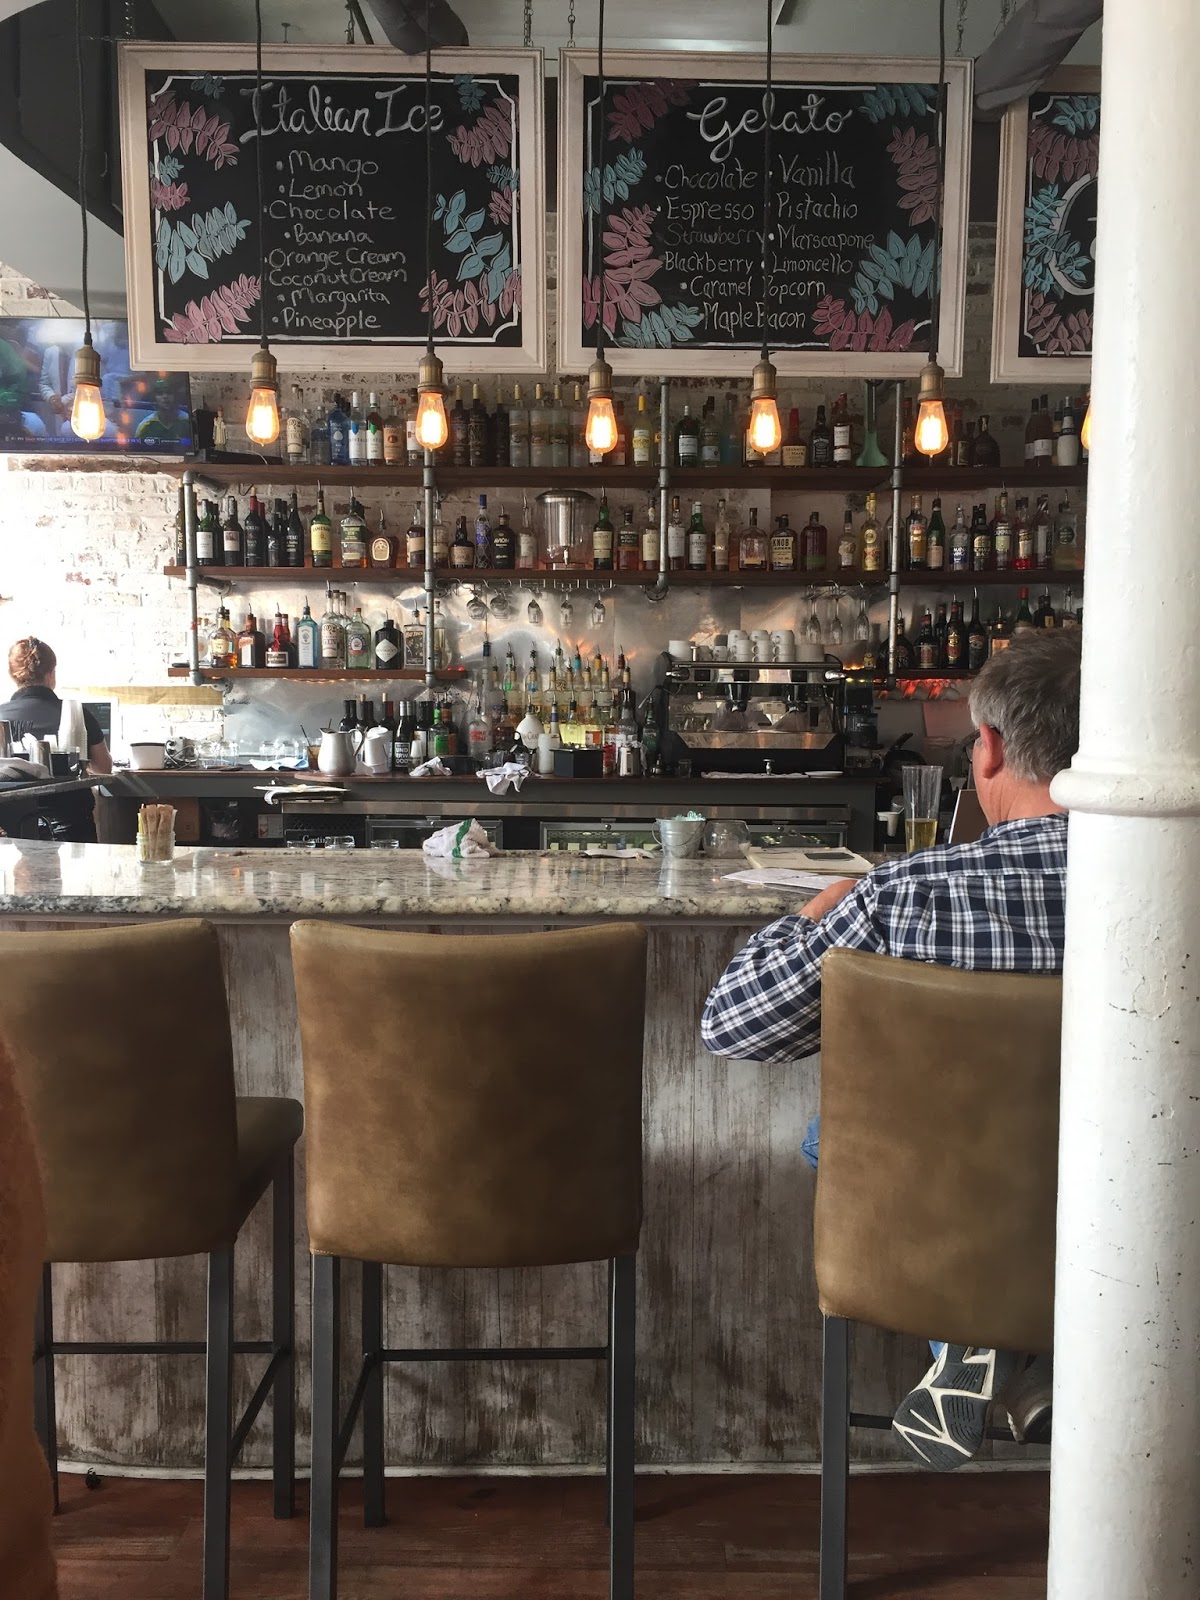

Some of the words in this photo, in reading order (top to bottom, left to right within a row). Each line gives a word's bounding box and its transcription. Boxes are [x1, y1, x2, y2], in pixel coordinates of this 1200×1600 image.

[239, 82, 371, 143] Italian
[374, 84, 444, 138] Ice
[686, 91, 853, 163] Gelato
[288, 150, 379, 185] Mango
[664, 158, 758, 191] Chocolate
[778, 150, 855, 189] Vanilla
[288, 178, 363, 200] Lemon
[268, 200, 396, 220] Chocolate
[665, 196, 755, 228] Espresso
[776, 191, 858, 221] Pistachio
[293, 223, 375, 246] Banana
[663, 222, 766, 253] Strawberry
[777, 223, 875, 250] Marscapone
[268, 248, 342, 272] Orange
[346, 247, 406, 264] Cream
[664, 251, 754, 274] Blackberry
[772, 252, 853, 275] Limoncello
[268, 268, 349, 287] Coconut
[350, 267, 408, 284] Cream
[690, 275, 753, 299] Caramel
[762, 275, 827, 304] Popcorn
[291, 287, 391, 316] Margarita
[281, 307, 382, 337] Pineapple
[703, 301, 752, 338] Maple
[772, 538, 790, 547] KNOB
